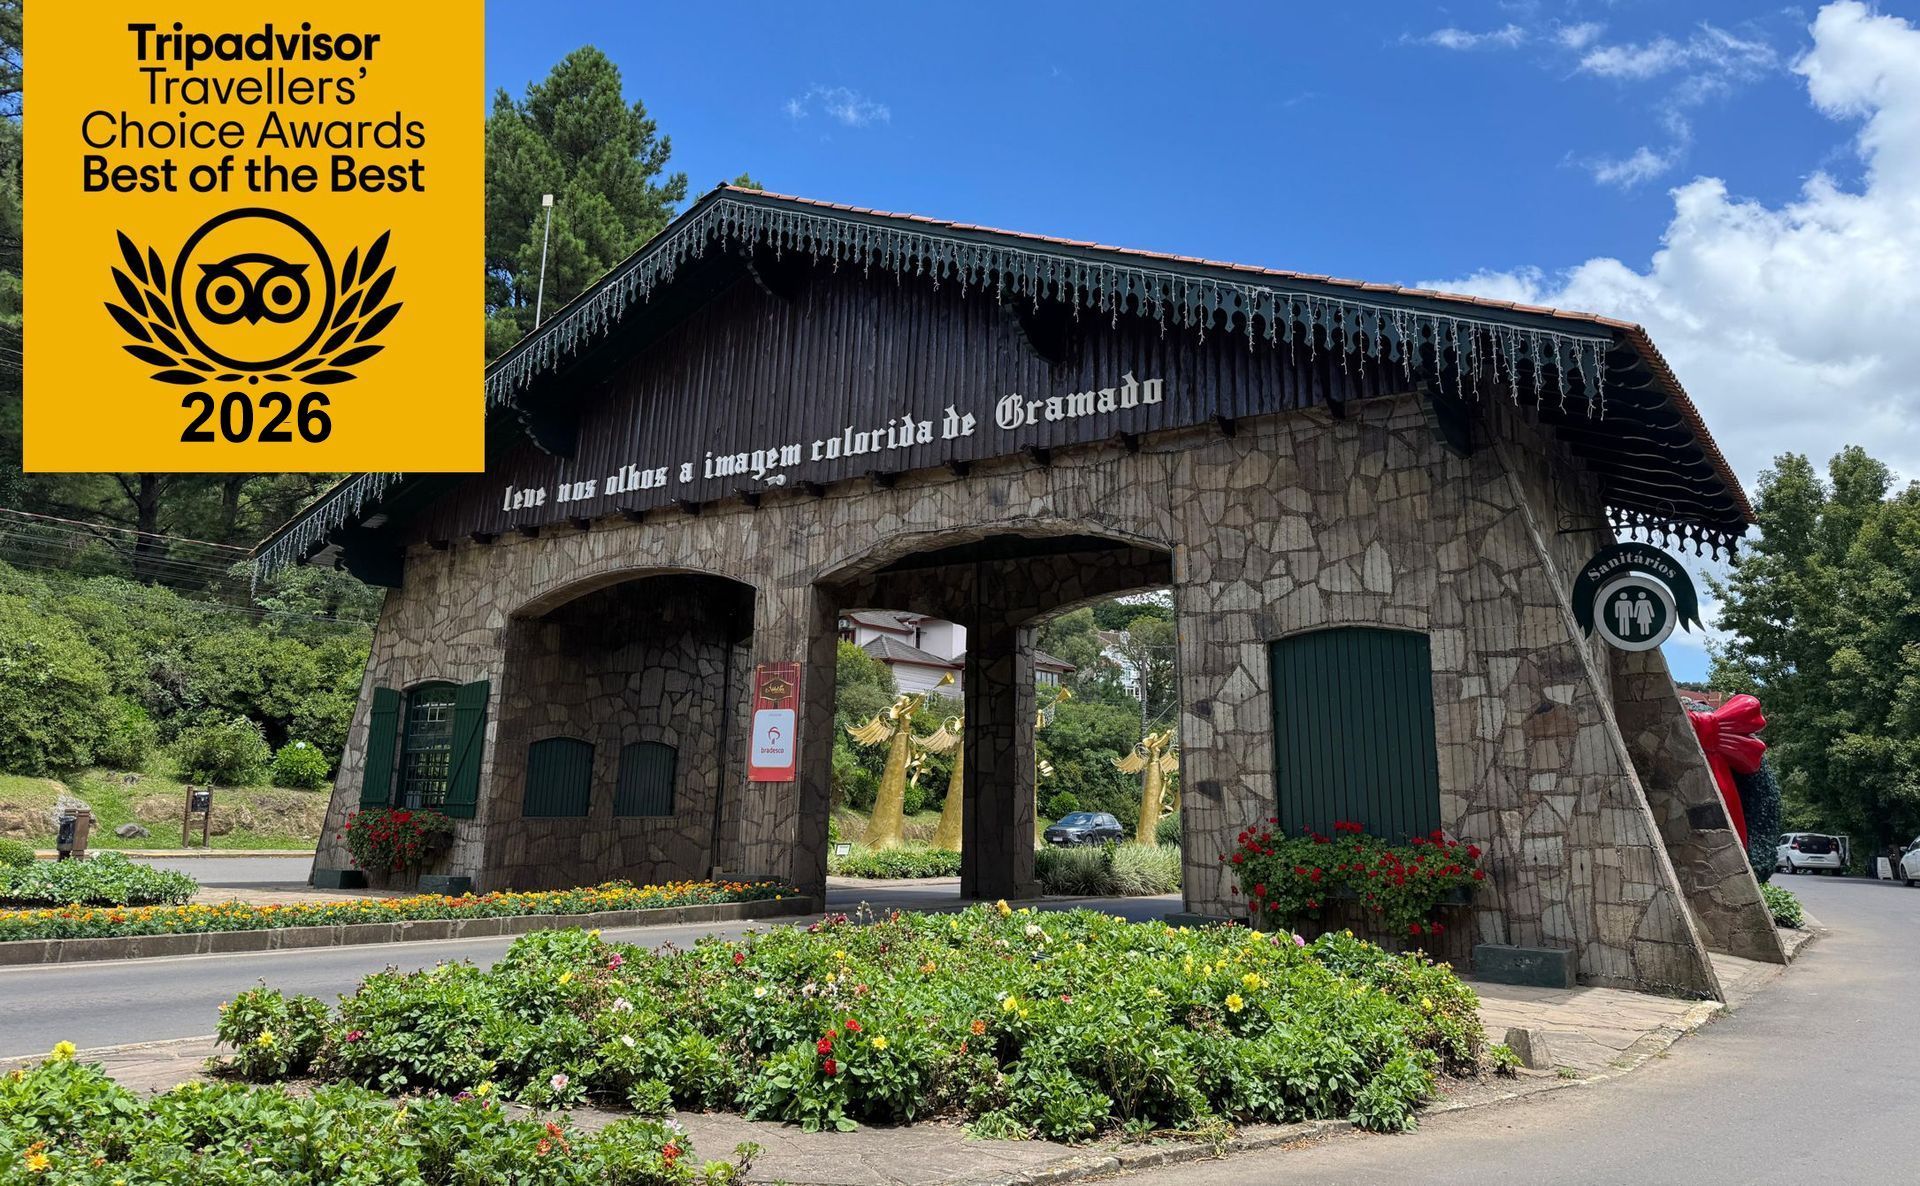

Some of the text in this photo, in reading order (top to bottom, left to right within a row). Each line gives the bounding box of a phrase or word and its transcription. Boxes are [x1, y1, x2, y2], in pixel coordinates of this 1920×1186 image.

[557, 479, 598, 502] nos
[604, 463, 669, 496] olhos
[679, 461, 694, 484] a
[704, 442, 802, 481] imagem
[811, 412, 934, 462] colorida
[941, 404, 977, 441] de
[995, 370, 1164, 430] Gramado
[1587, 550, 1677, 581] Sanitários
[761, 747, 785, 755] bradesco
